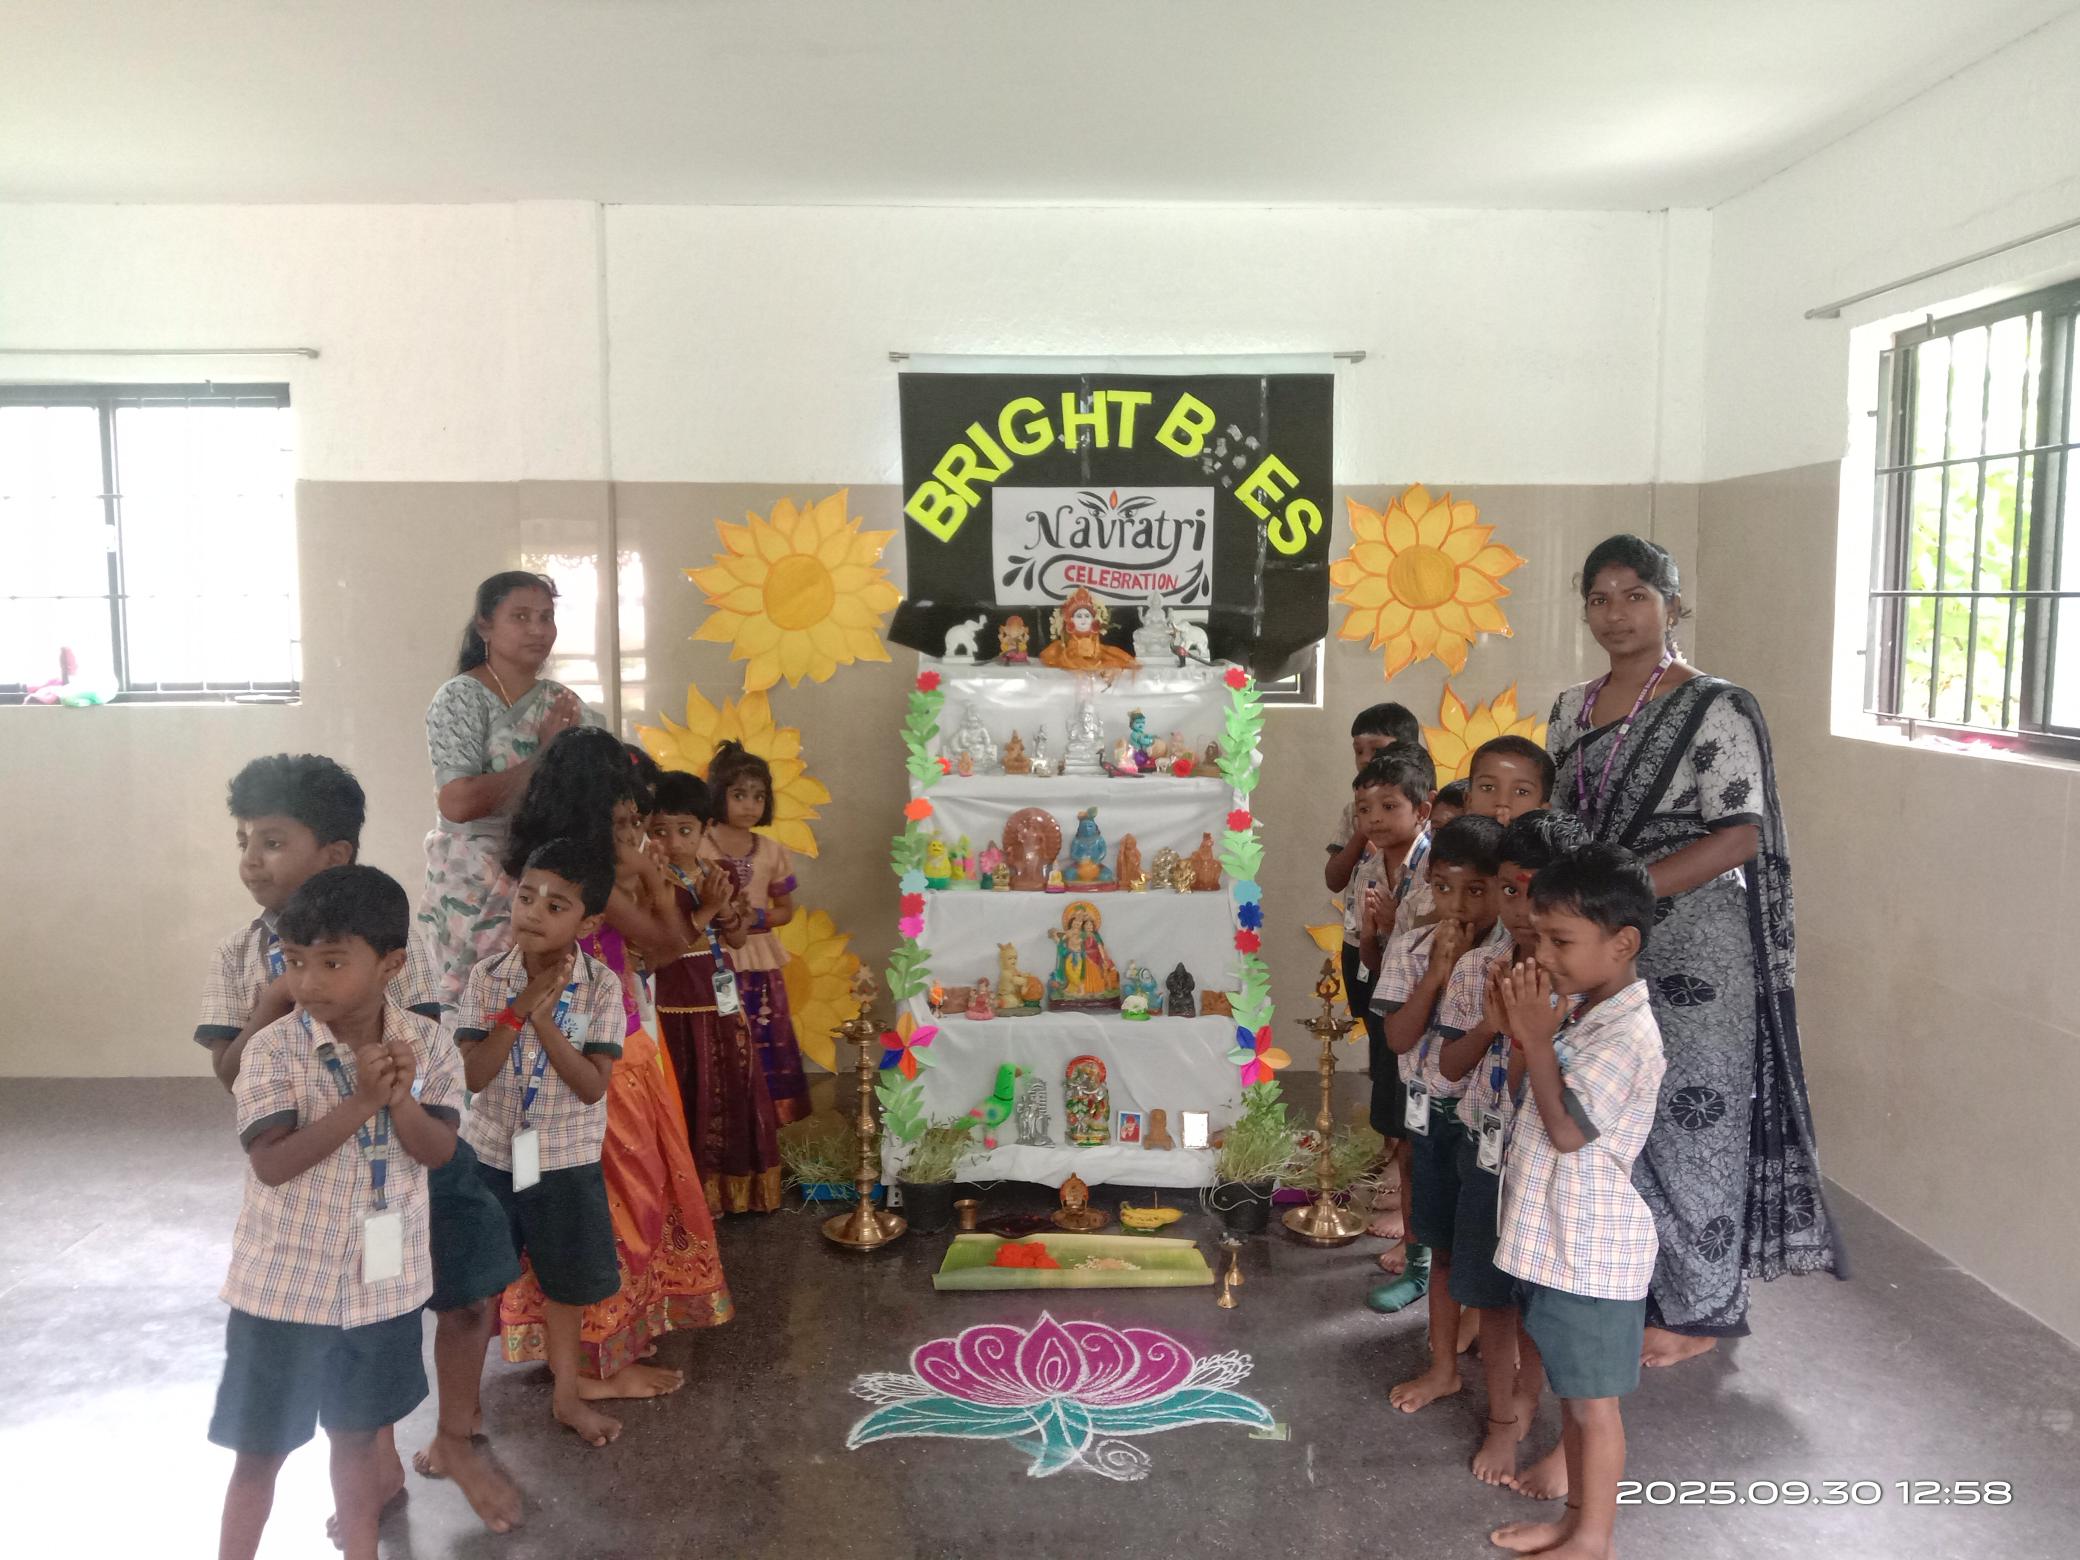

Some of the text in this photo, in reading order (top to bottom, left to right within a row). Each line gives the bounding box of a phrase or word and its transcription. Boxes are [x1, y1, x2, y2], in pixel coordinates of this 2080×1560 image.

[904, 389, 1323, 556] BRIGHT BES
[1023, 505, 1207, 552] Navratri
[1063, 564, 1180, 591] CELEBRATION
